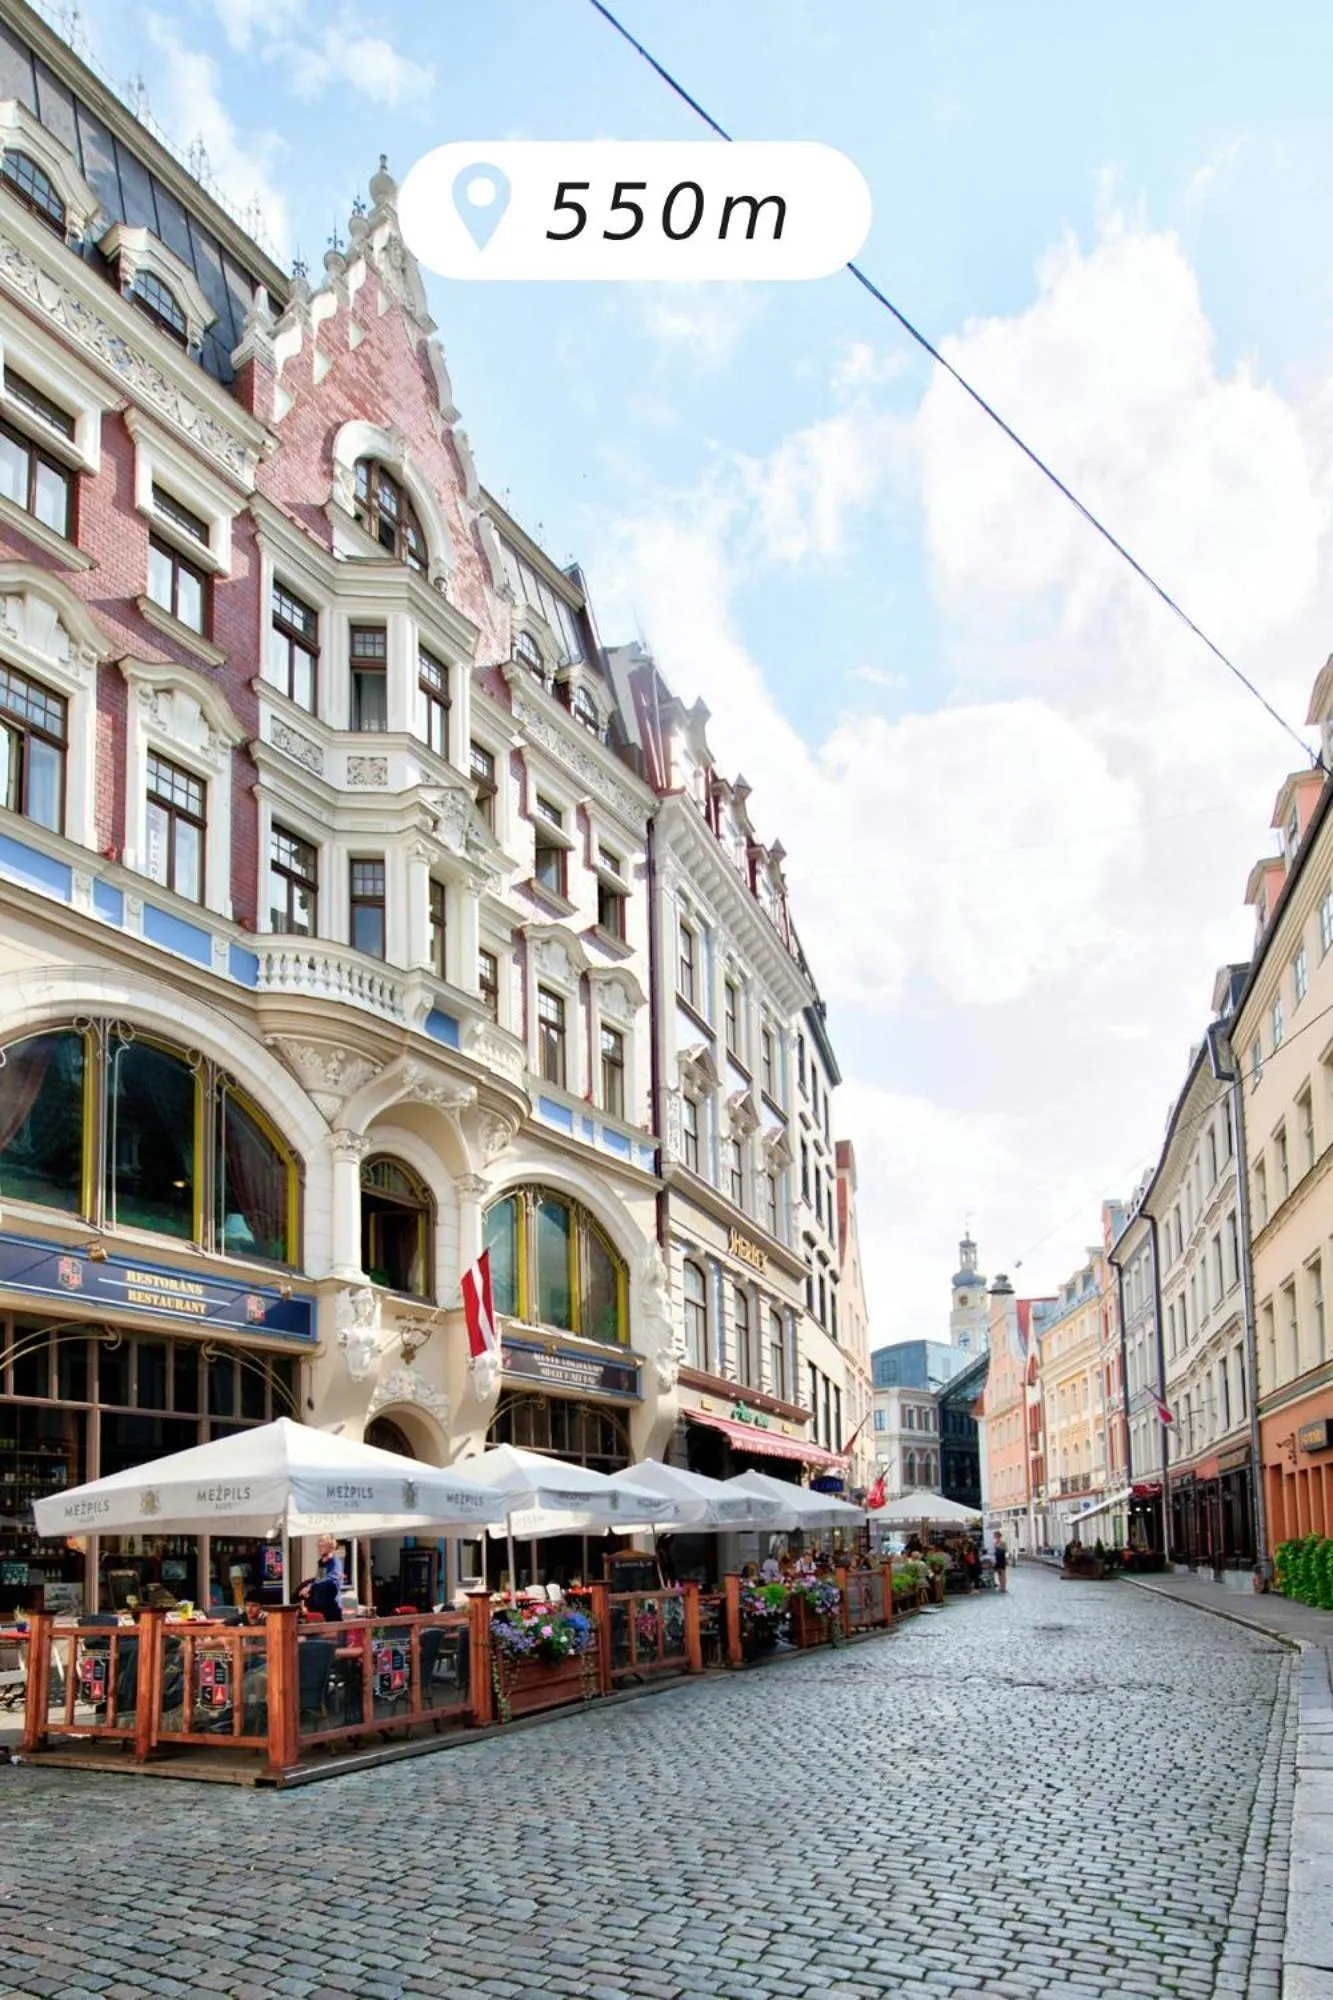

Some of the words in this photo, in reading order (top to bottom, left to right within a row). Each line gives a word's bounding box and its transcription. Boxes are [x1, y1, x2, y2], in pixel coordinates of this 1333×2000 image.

[128, 1289, 207, 1315] RESTAURANT
[197, 1484, 251, 1503] MEŽPILS
[326, 1482, 374, 1500] MEŽPILS
[64, 1499, 110, 1518] MEŽPILS
